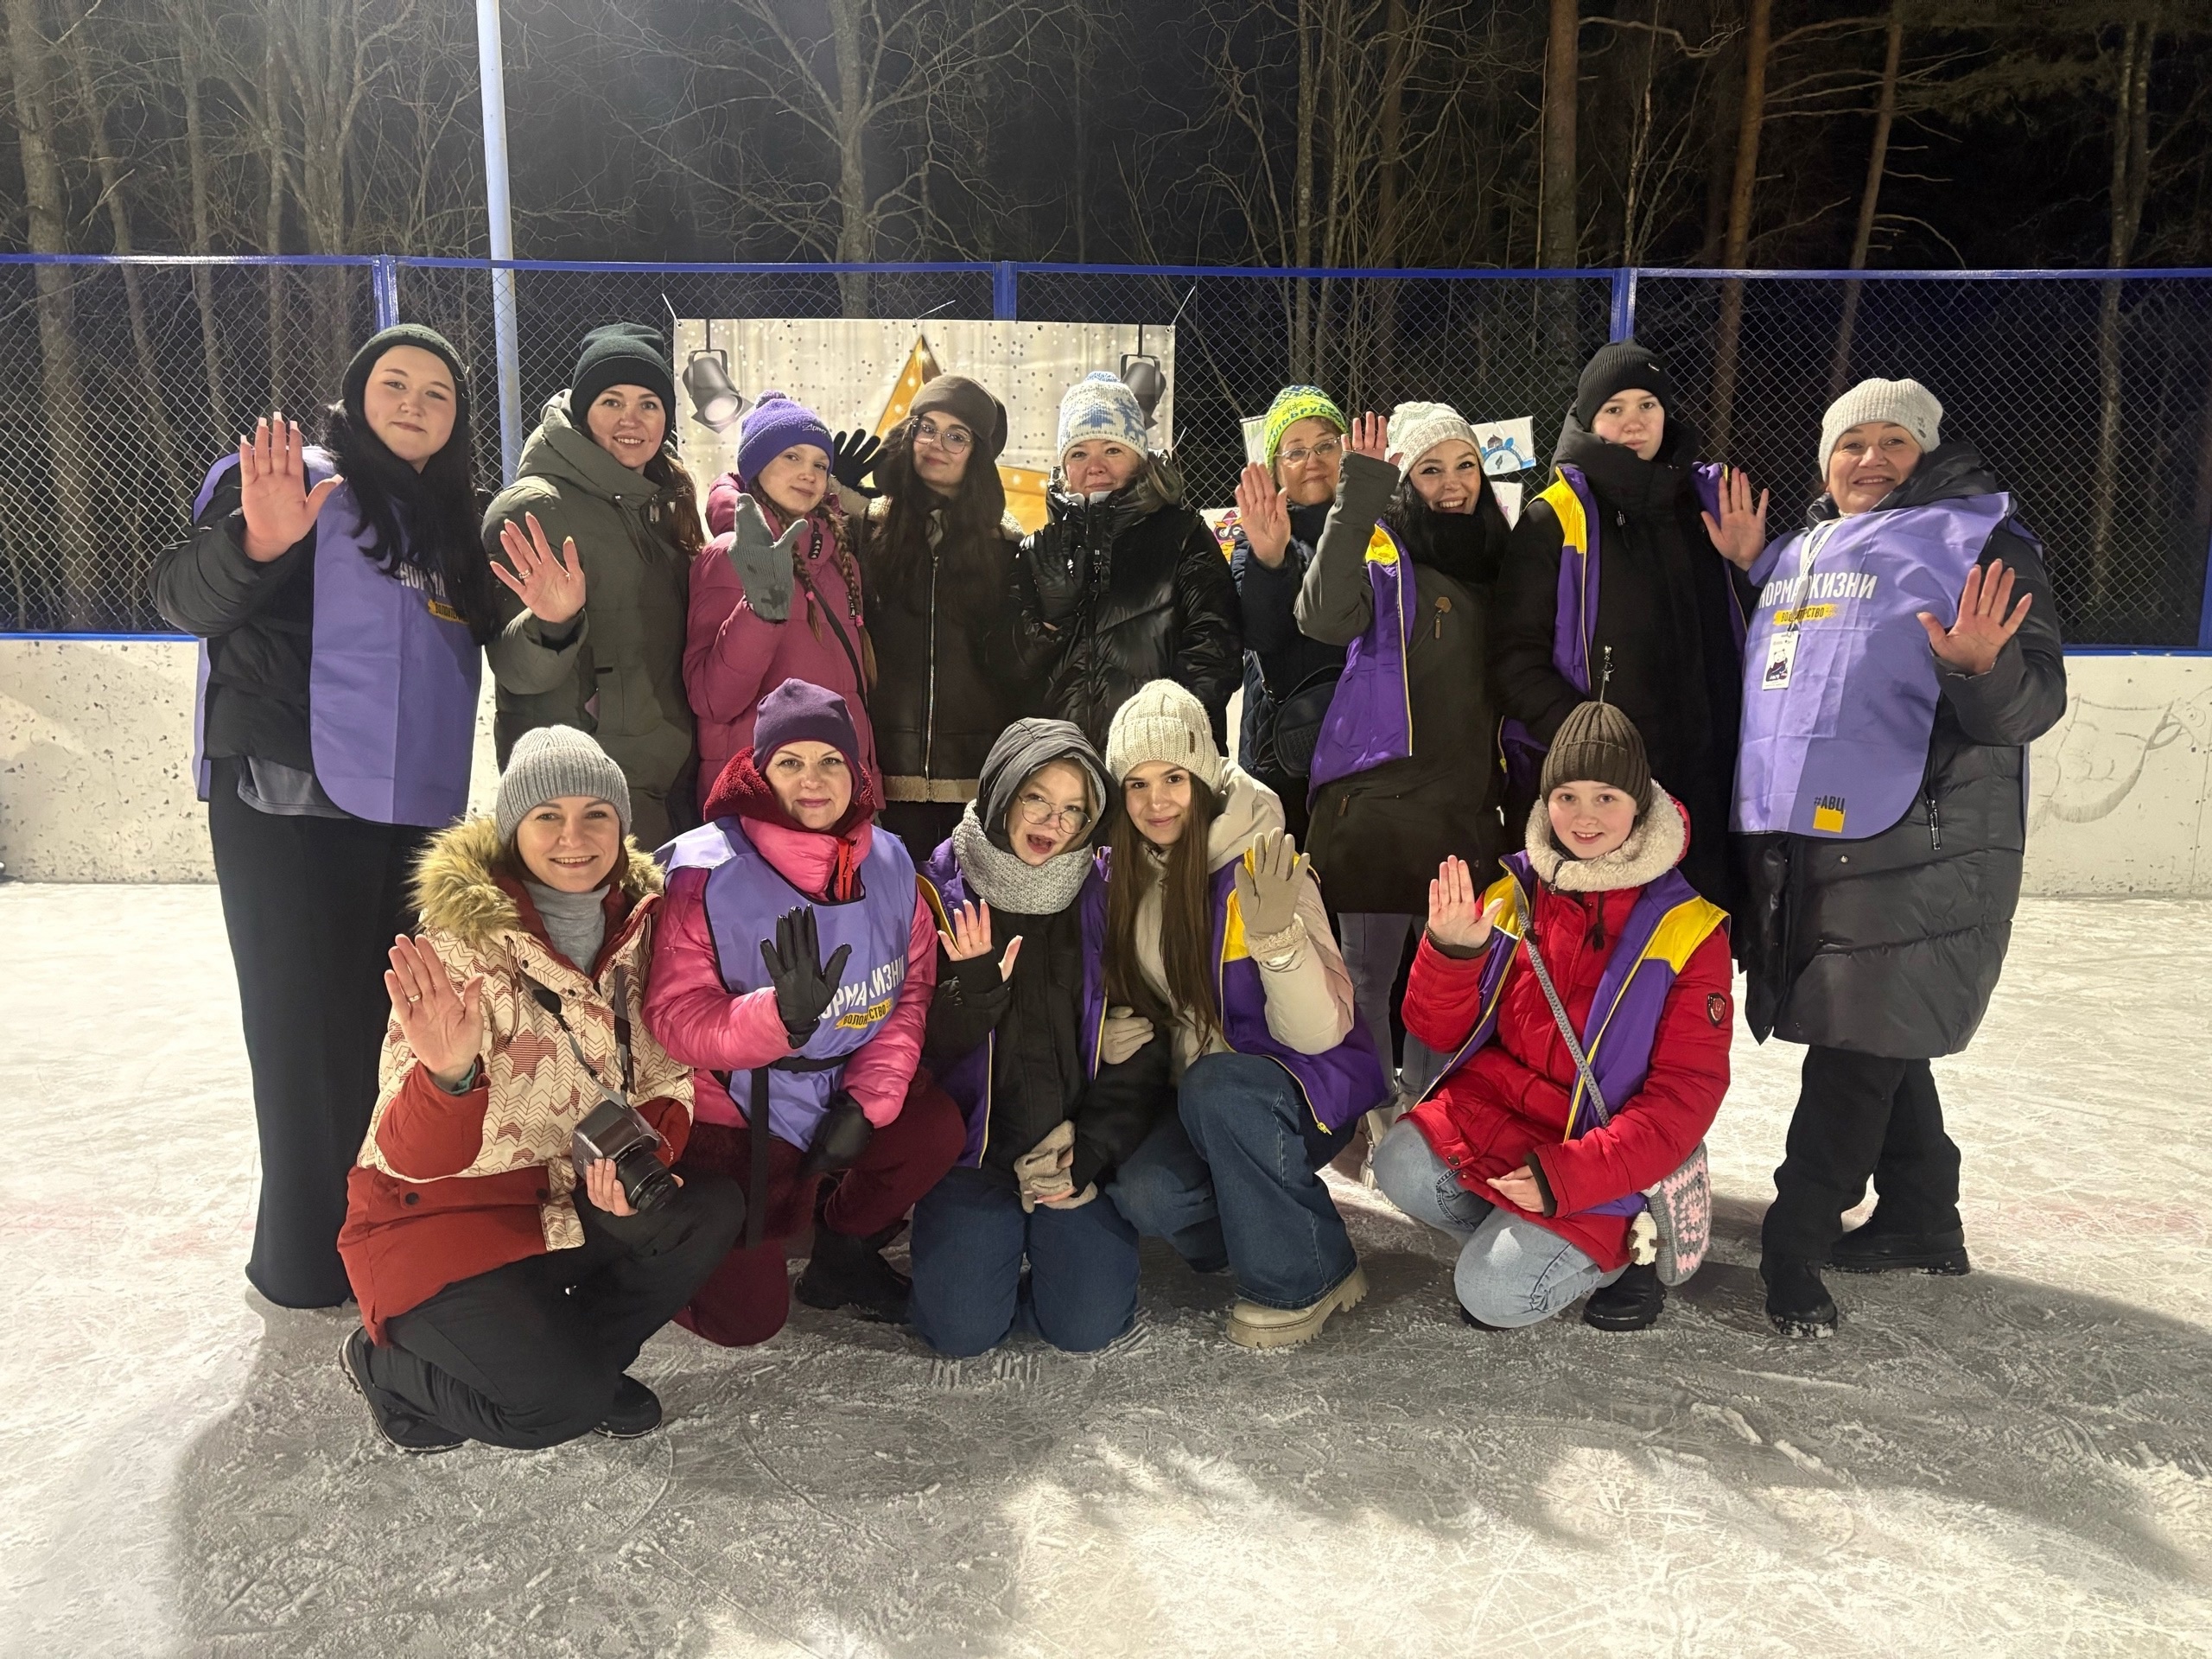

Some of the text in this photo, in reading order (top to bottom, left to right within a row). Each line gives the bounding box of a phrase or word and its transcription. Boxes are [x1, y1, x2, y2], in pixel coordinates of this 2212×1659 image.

[1805, 572, 1878, 600] ЖИЗНИ
[1814, 795, 1846, 815] #АВЦ
[814, 955, 905, 1020] ОРМА ИЗНИ
